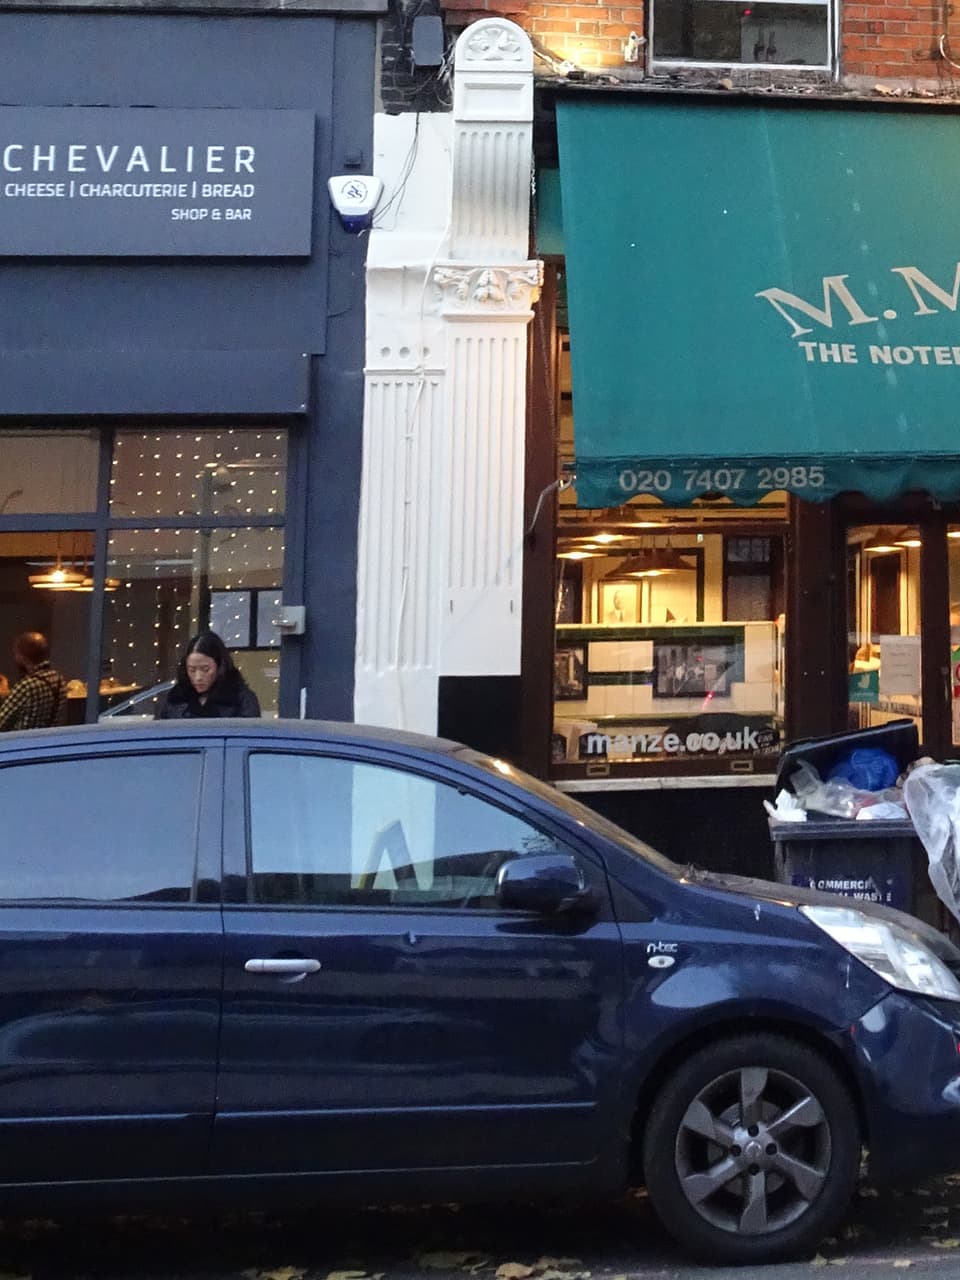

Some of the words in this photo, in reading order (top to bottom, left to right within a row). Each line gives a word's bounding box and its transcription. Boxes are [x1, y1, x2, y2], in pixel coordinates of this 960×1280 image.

[3, 145, 256, 172] CHEVALIER
[5, 183, 65, 197] CHEESE
[80, 183, 188, 197] CHARCUTERIE
[202, 184, 255, 197] BREAD
[171, 208, 208, 220] SHOP
[211, 209, 221, 220] &
[225, 208, 252, 220] BAR
[799, 341, 857, 363] THE
[619, 470, 672, 491] 020
[683, 469, 747, 490] 7407
[757, 467, 825, 489] 2985
[587, 726, 759, 754] manze.co.uk
